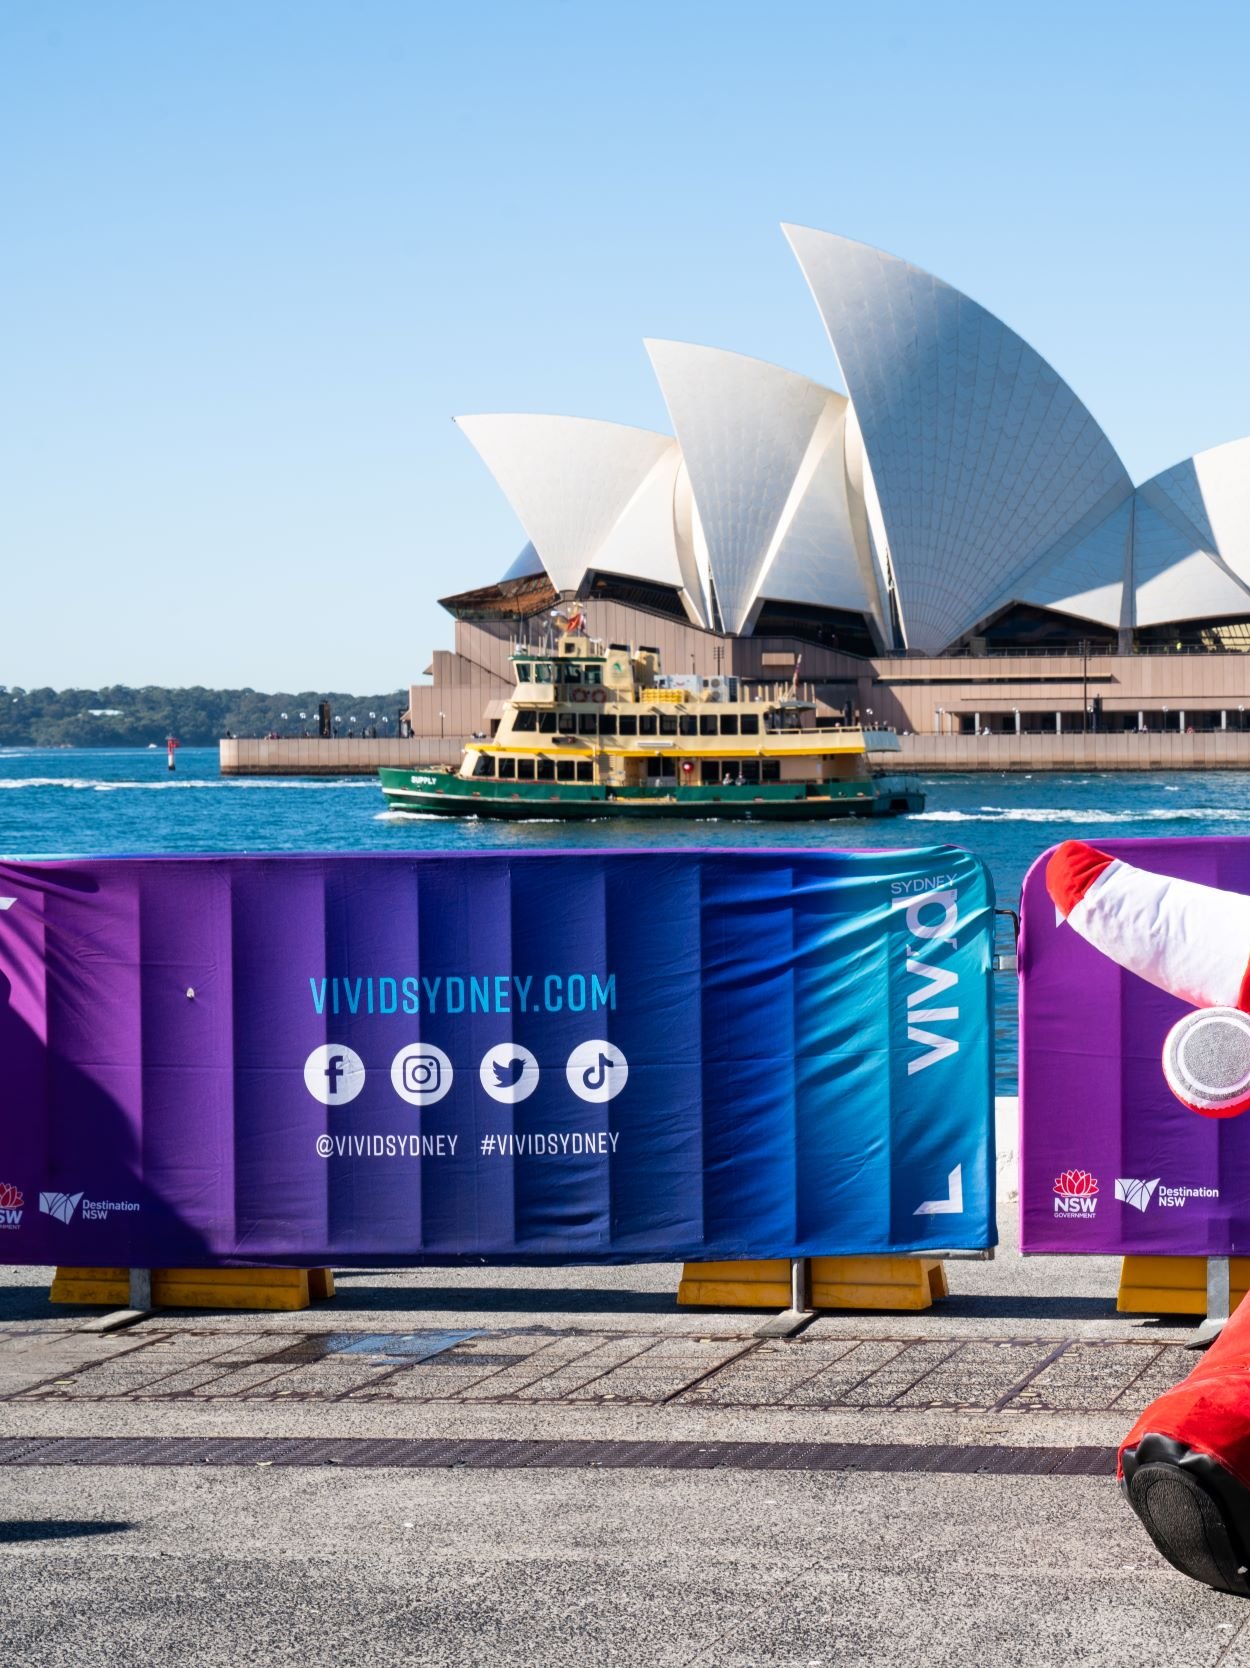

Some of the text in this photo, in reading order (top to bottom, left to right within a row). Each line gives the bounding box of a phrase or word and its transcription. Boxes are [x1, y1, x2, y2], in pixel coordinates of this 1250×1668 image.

[411, 775, 437, 785] SUPPLY
[890, 873, 958, 895] SYDNEY
[310, 973, 617, 1015] VIVIDSYDNEY.COM
[316, 1131, 620, 1158] @VIVIDSYDNEY #VIVIDSYDNEY
[1158, 1185, 1219, 1198] Destination
[82, 1199, 140, 1211] Destination
[1054, 1197, 1098, 1213] NSW
[1158, 1197, 1186, 1207] NSW
[82, 1210, 108, 1220] NSW
